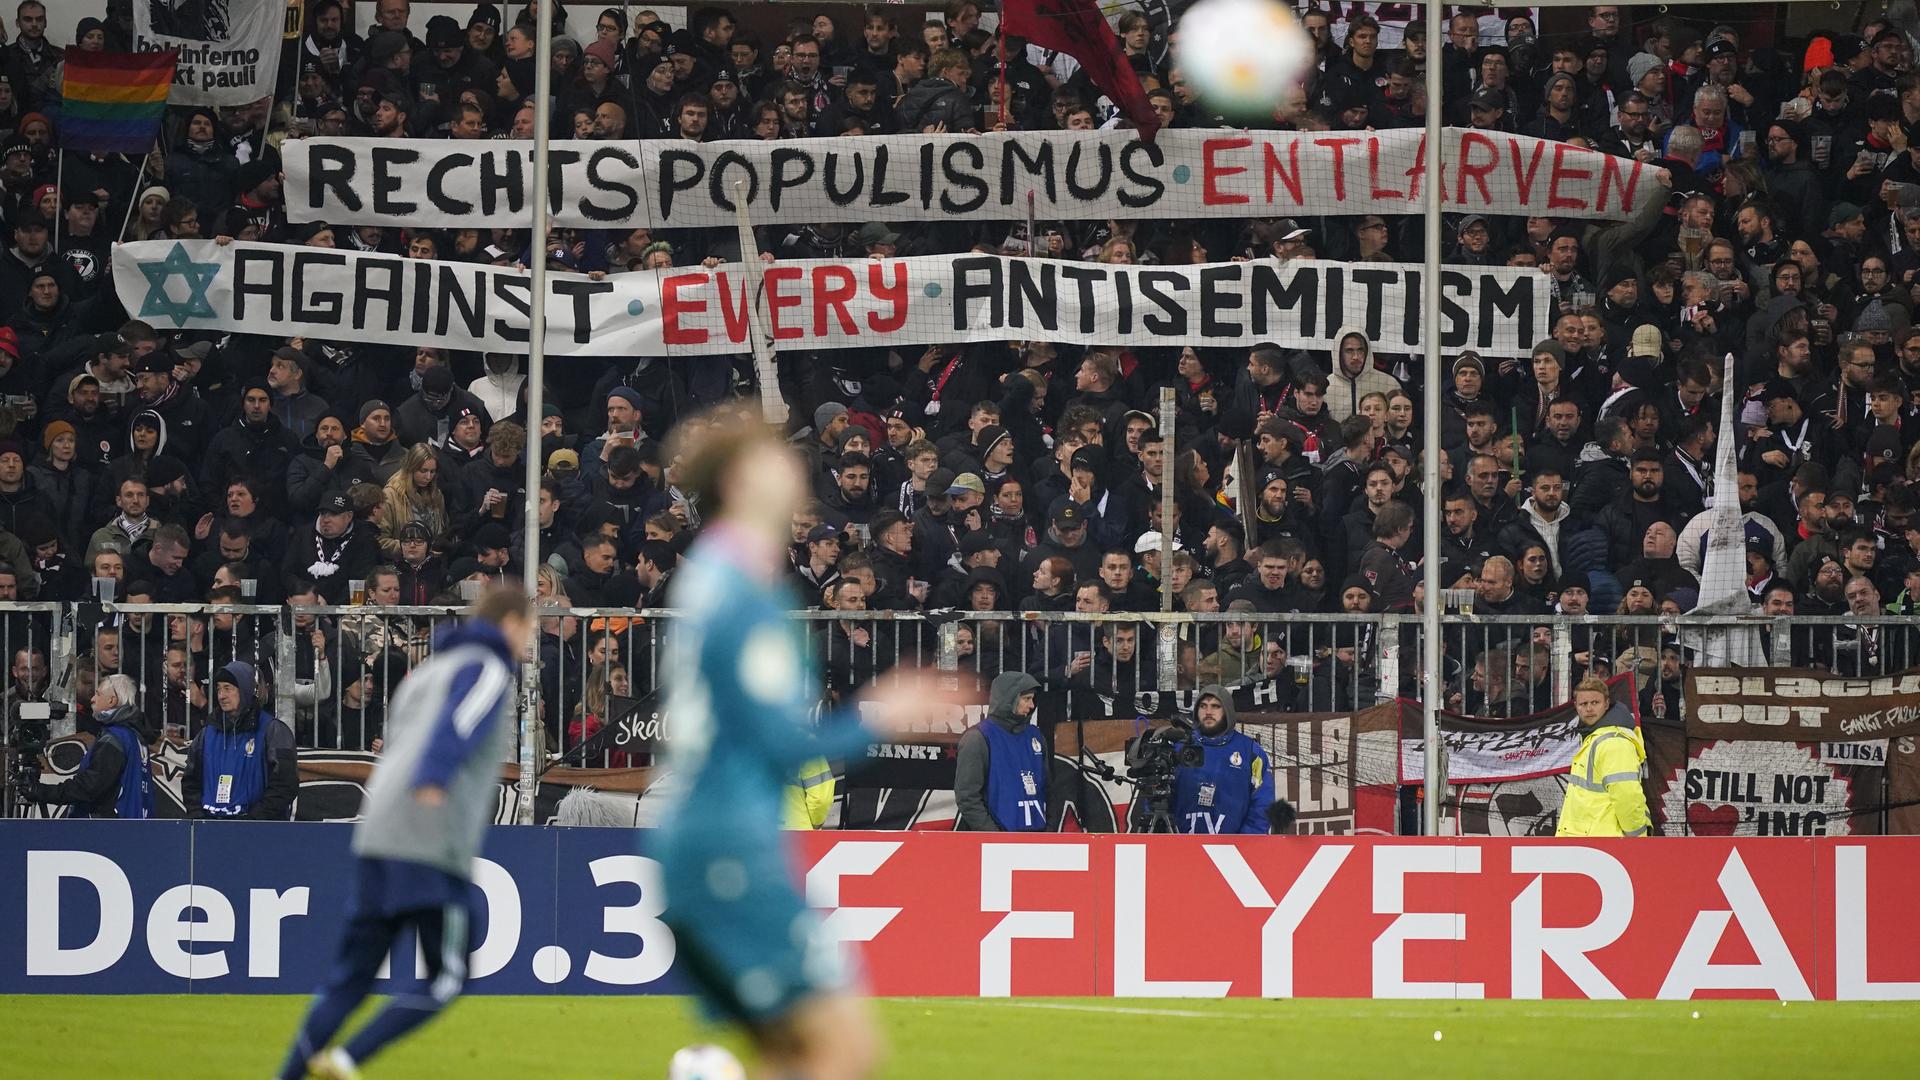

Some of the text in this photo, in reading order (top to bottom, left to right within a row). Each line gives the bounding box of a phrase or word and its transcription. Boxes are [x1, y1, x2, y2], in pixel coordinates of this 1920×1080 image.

[202, 65, 256, 92] pauli
[1203, 132, 1643, 214] ENTLARVEN
[233, 248, 1534, 349] AGAINST EVERY ANTISEMITISM
[1697, 704, 1829, 728] OUT
[866, 743, 941, 761] SANKT
[1827, 742, 1885, 761] LUISA
[1687, 769, 1830, 804] STILL NOT
[26, 850, 310, 980] Der
